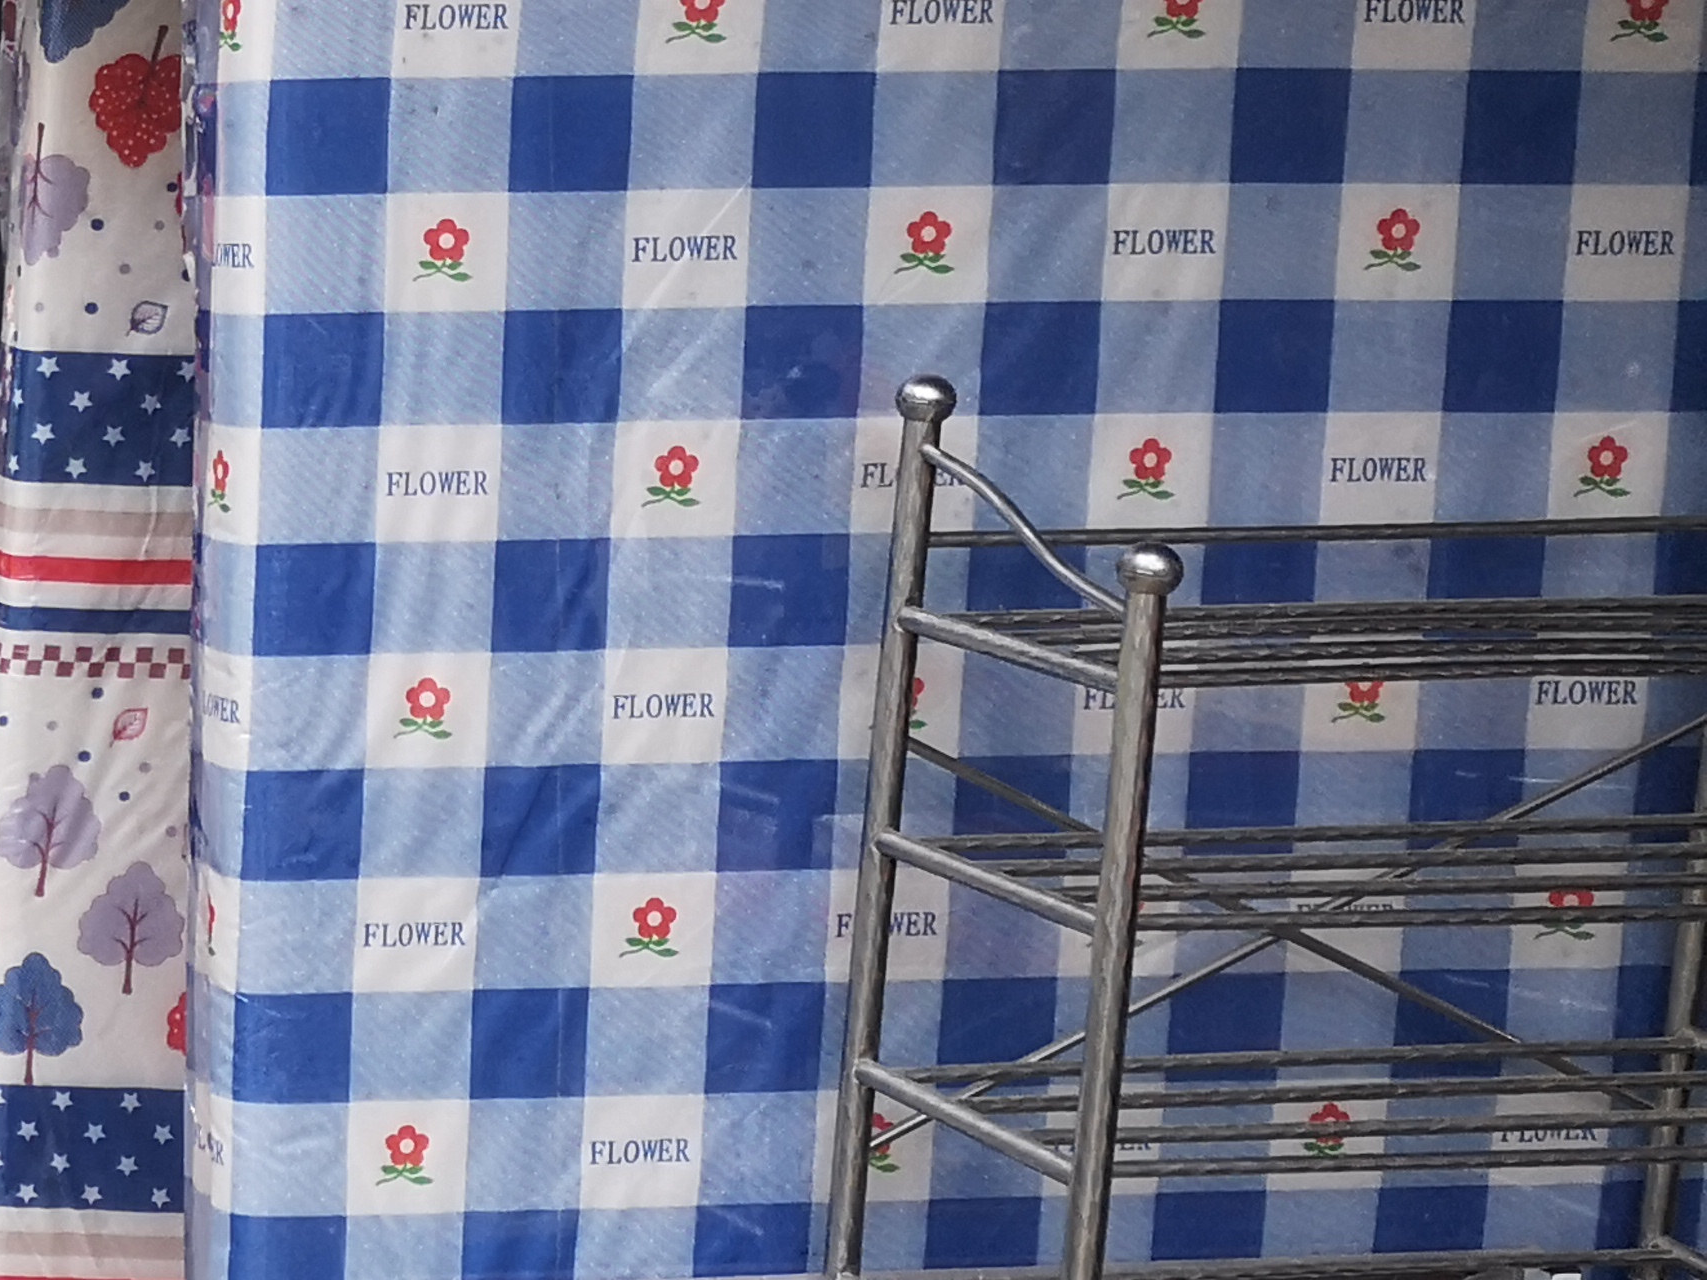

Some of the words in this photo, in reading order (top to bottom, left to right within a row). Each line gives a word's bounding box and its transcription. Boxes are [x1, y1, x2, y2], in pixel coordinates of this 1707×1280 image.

[404, 4, 508, 30] FLOWER
[632, 235, 737, 262] FLOWER
[1113, 229, 1215, 255] FLOWER
[1576, 230, 1674, 256] FLOWER
[1330, 457, 1427, 483] FLOWER
[387, 471, 488, 497] FLOWER
[1535, 680, 1637, 705] FLOWER
[613, 693, 714, 719] FLOWER
[363, 922, 465, 948] FLOWER
[590, 1139, 690, 1165] FLOWER
